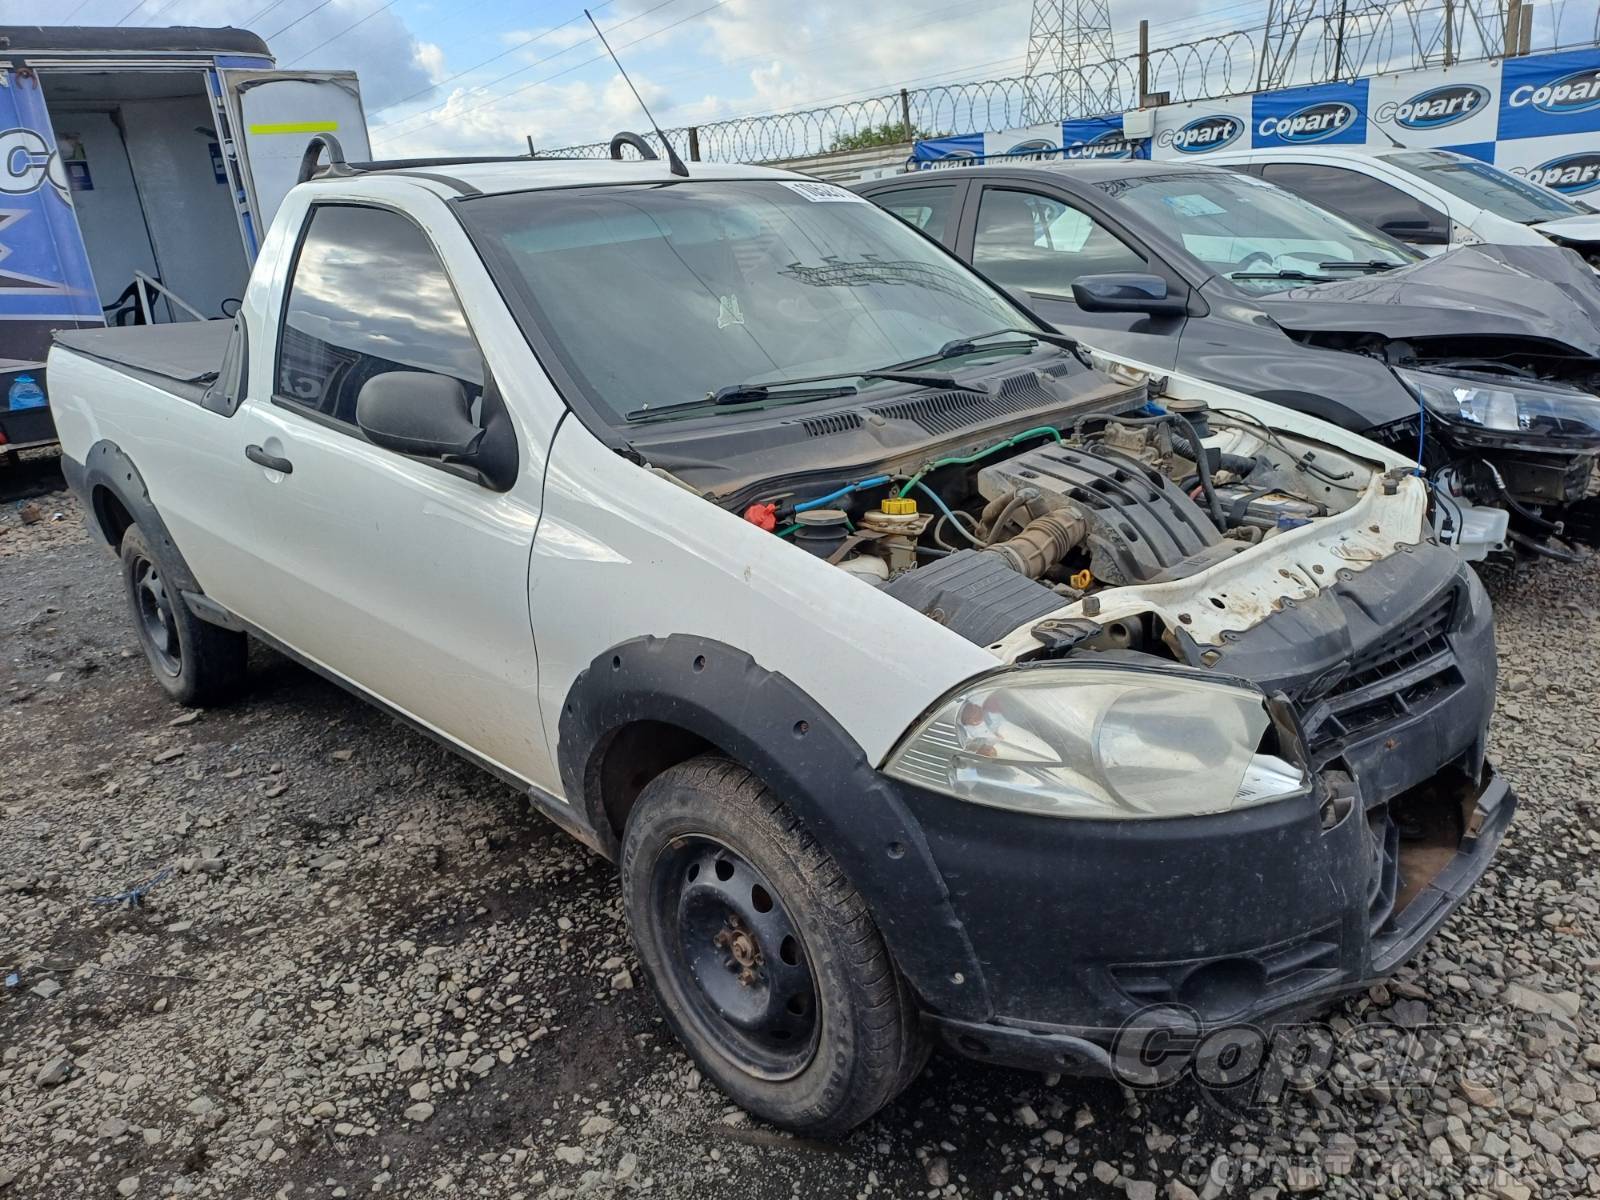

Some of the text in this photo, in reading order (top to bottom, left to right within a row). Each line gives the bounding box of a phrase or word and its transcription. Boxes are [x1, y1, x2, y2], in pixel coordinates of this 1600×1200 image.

[1374, 90, 1475, 124] Copart
[1508, 80, 1600, 107] Copar
[1157, 121, 1234, 149] Copart
[1258, 108, 1348, 137] Copart
